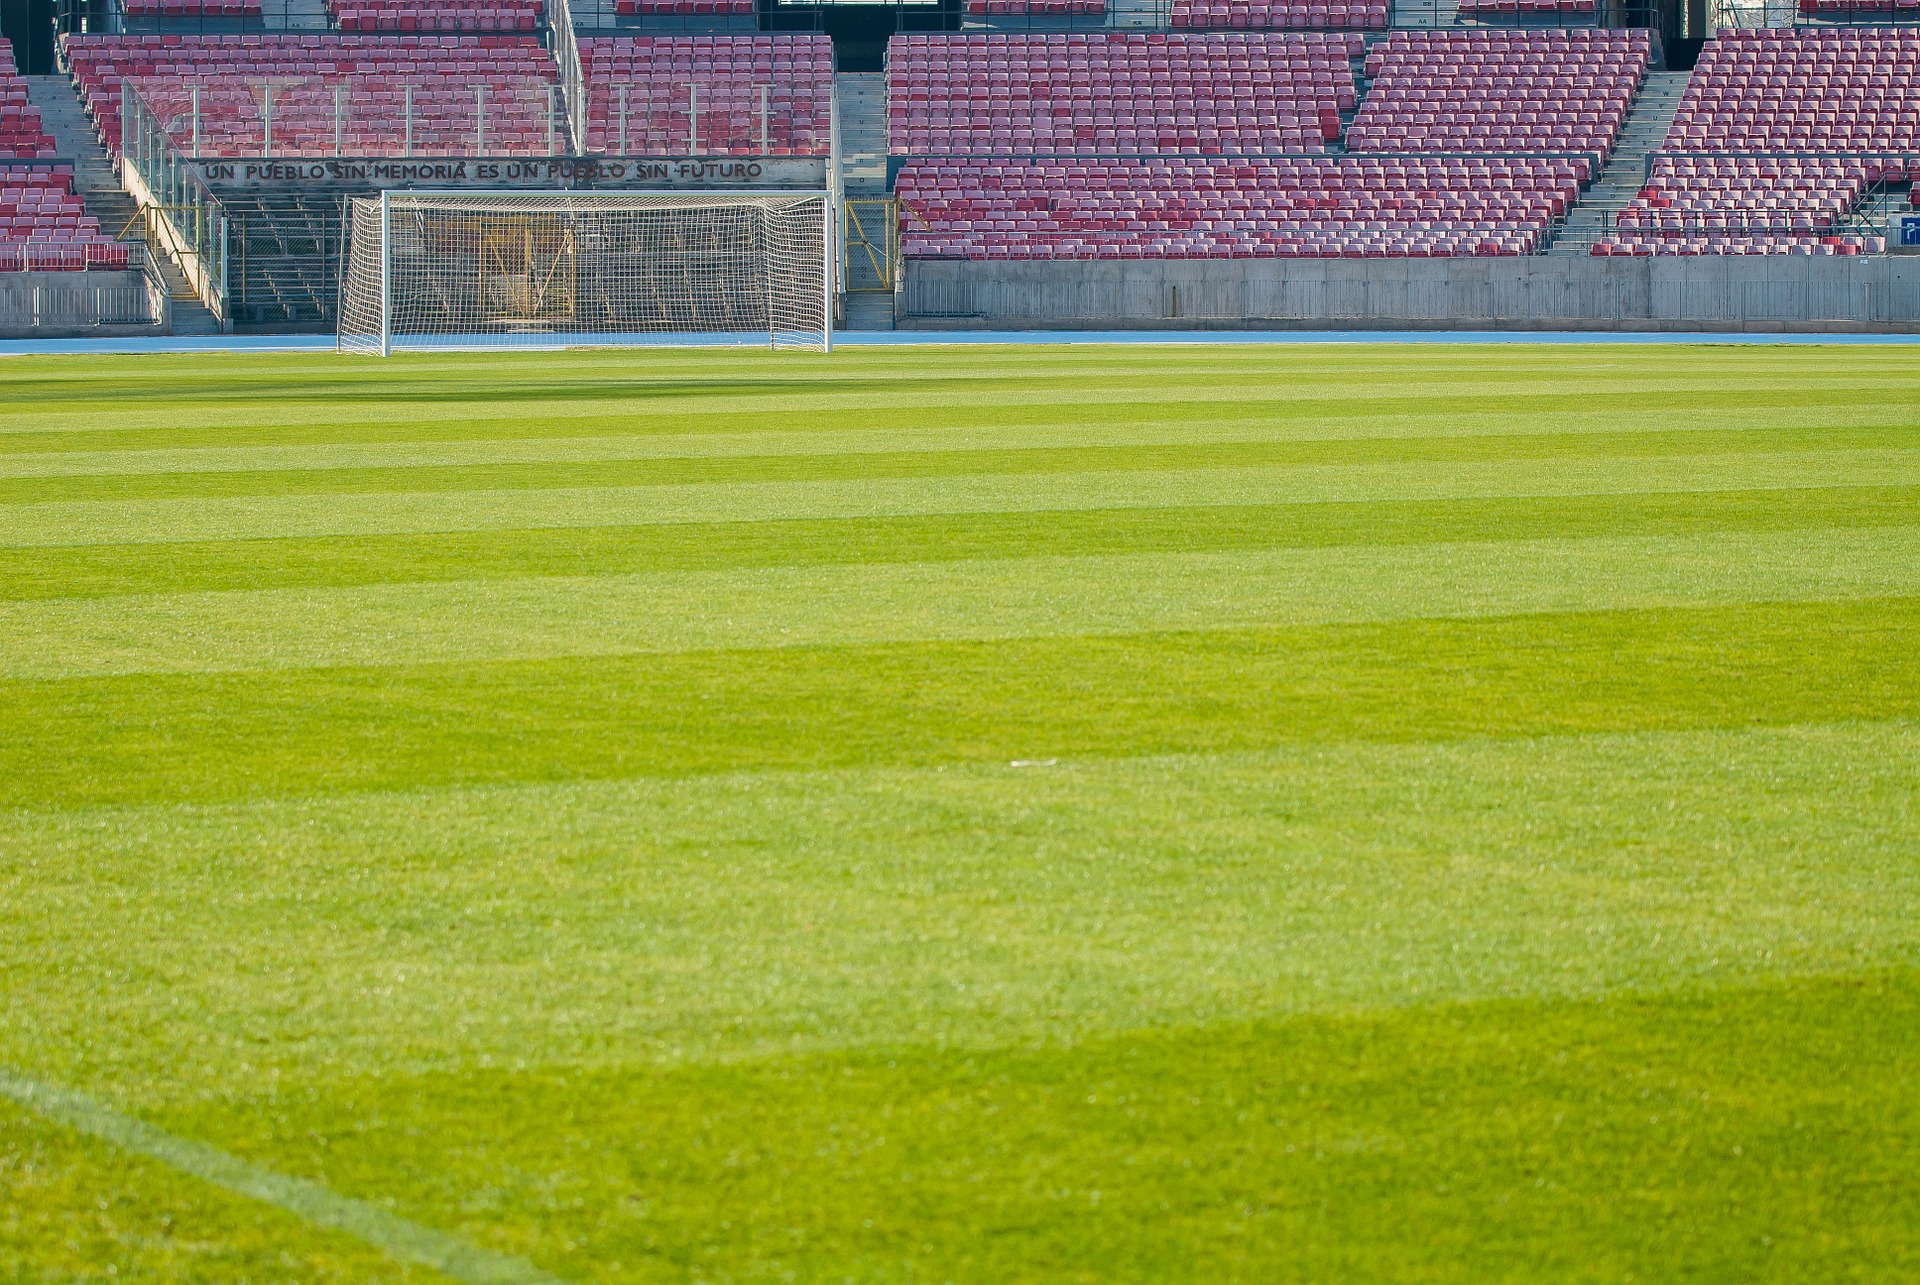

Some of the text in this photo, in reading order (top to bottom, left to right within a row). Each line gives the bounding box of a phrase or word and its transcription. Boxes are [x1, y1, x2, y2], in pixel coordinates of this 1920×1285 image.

[205, 163, 762, 179] UN PUEBLO SIN MEMORIA ES UN PUEBLO SIN FUTURO
